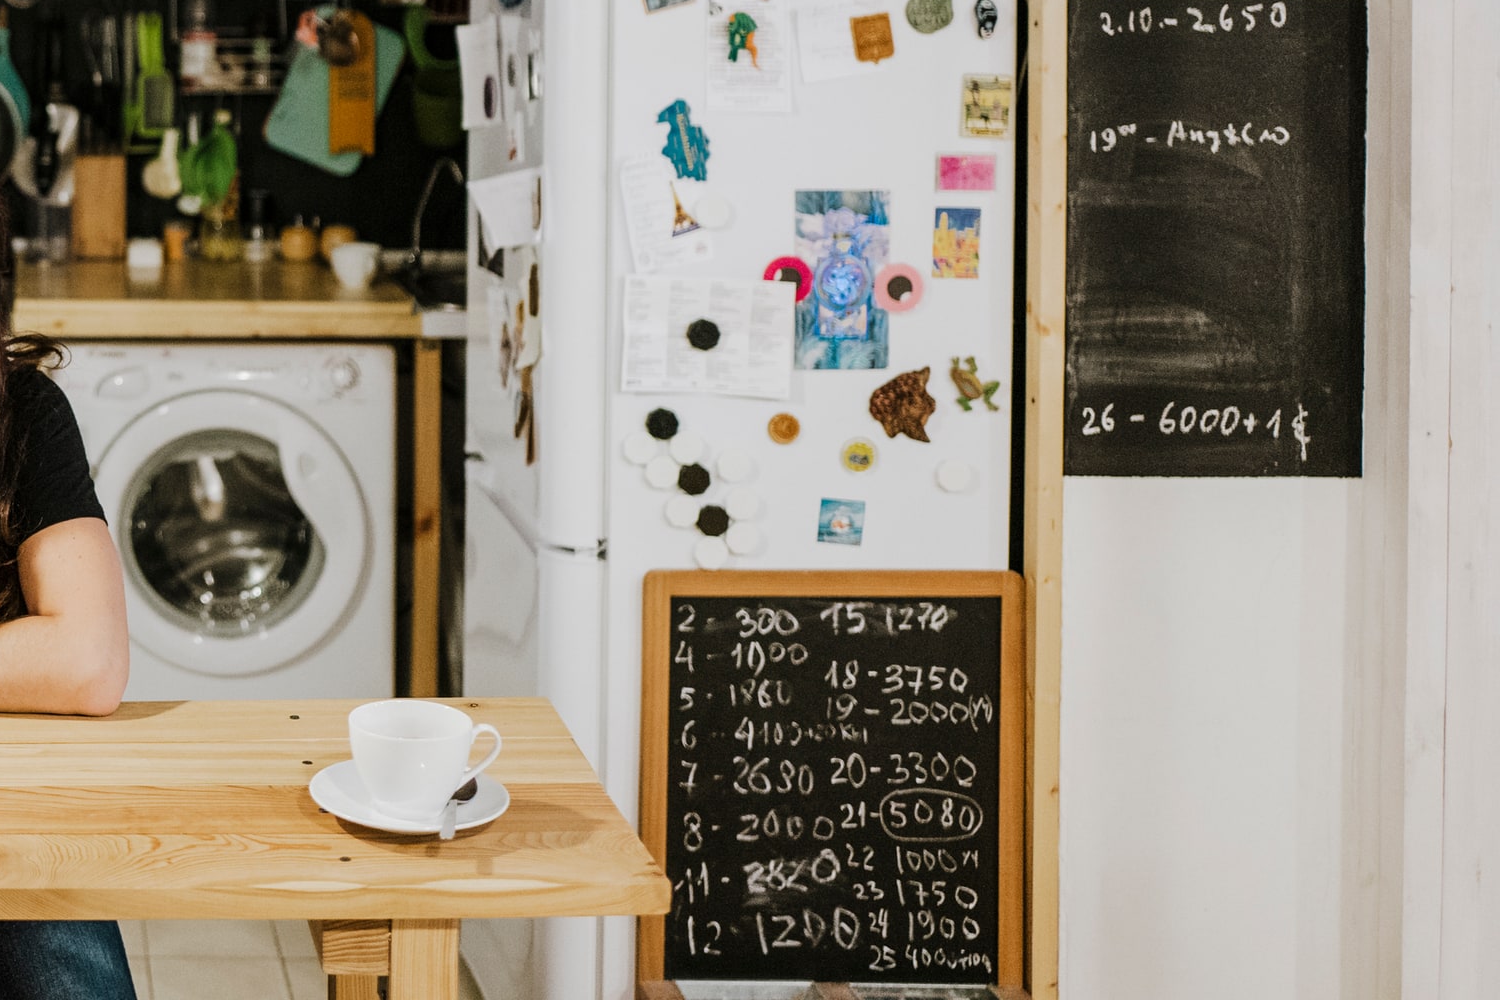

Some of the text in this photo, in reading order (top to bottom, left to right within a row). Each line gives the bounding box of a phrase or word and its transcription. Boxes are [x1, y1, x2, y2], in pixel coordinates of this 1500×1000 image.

[1080, 400, 1116, 437] 26
[675, 602, 697, 634] 2
[734, 607, 801, 640] 300
[817, 600, 876, 638] 15
[672, 638, 697, 675] 4
[729, 639, 811, 679] 1000
[678, 685, 697, 713] 5
[679, 718, 699, 751] 6
[677, 758, 700, 796] 7
[682, 811, 705, 853] 8
[735, 808, 836, 842] 2000
[844, 842, 876, 873] 22
[851, 878, 980, 911] 23 1750
[686, 914, 723, 956] 12
[866, 907, 982, 942] 24 1900
[867, 944, 898, 973] 25
